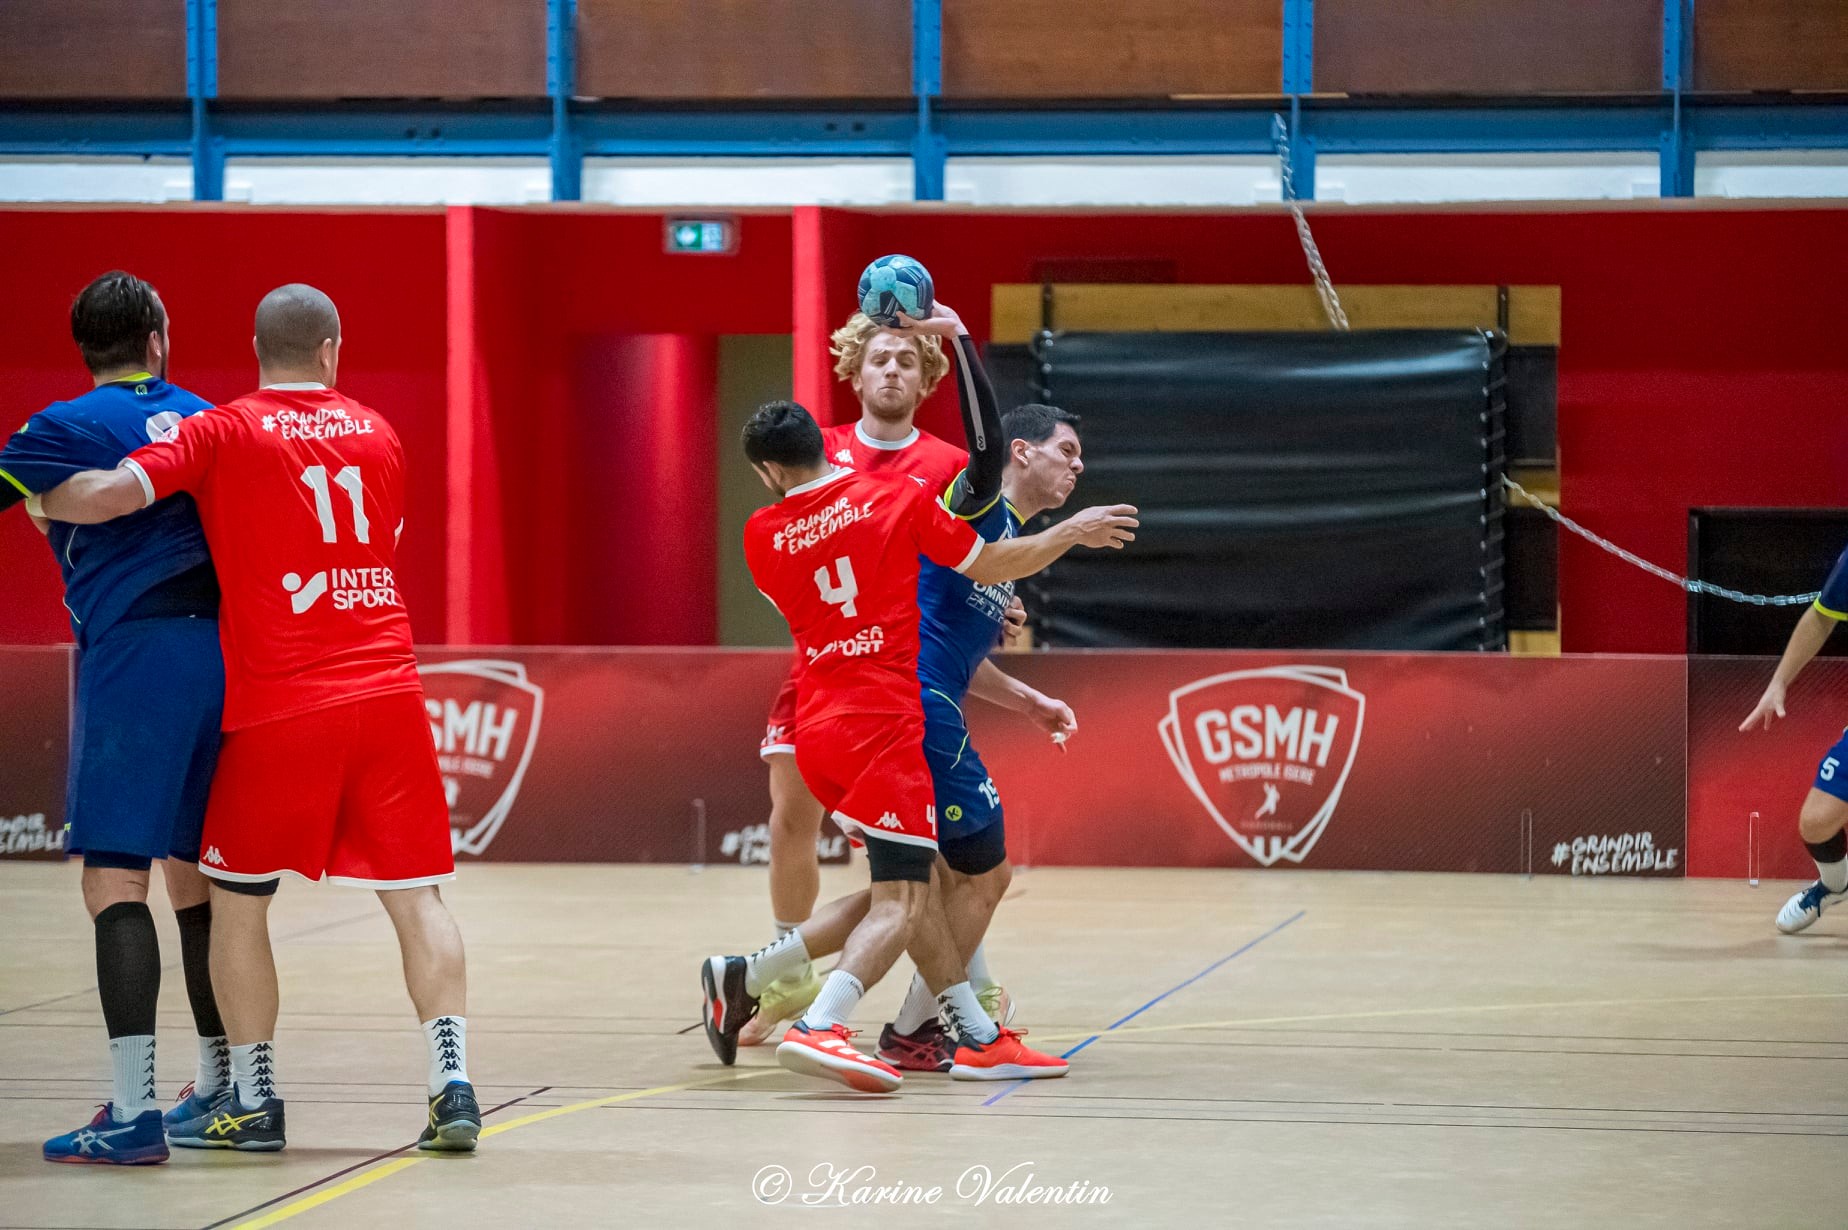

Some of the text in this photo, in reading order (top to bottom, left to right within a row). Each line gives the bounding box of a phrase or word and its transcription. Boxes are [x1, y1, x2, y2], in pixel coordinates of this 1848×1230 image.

[281, 419, 374, 441] ENSEMBLE
[300, 464, 370, 544] 11
[788, 501, 874, 555] ENSEMBLE
[331, 567, 395, 589] INTER
[813, 555, 859, 618] 4
[1195, 704, 1340, 768] GSMH
[1820, 756, 1841, 781] 5
[1571, 848, 1678, 876] ENSEMBLE
